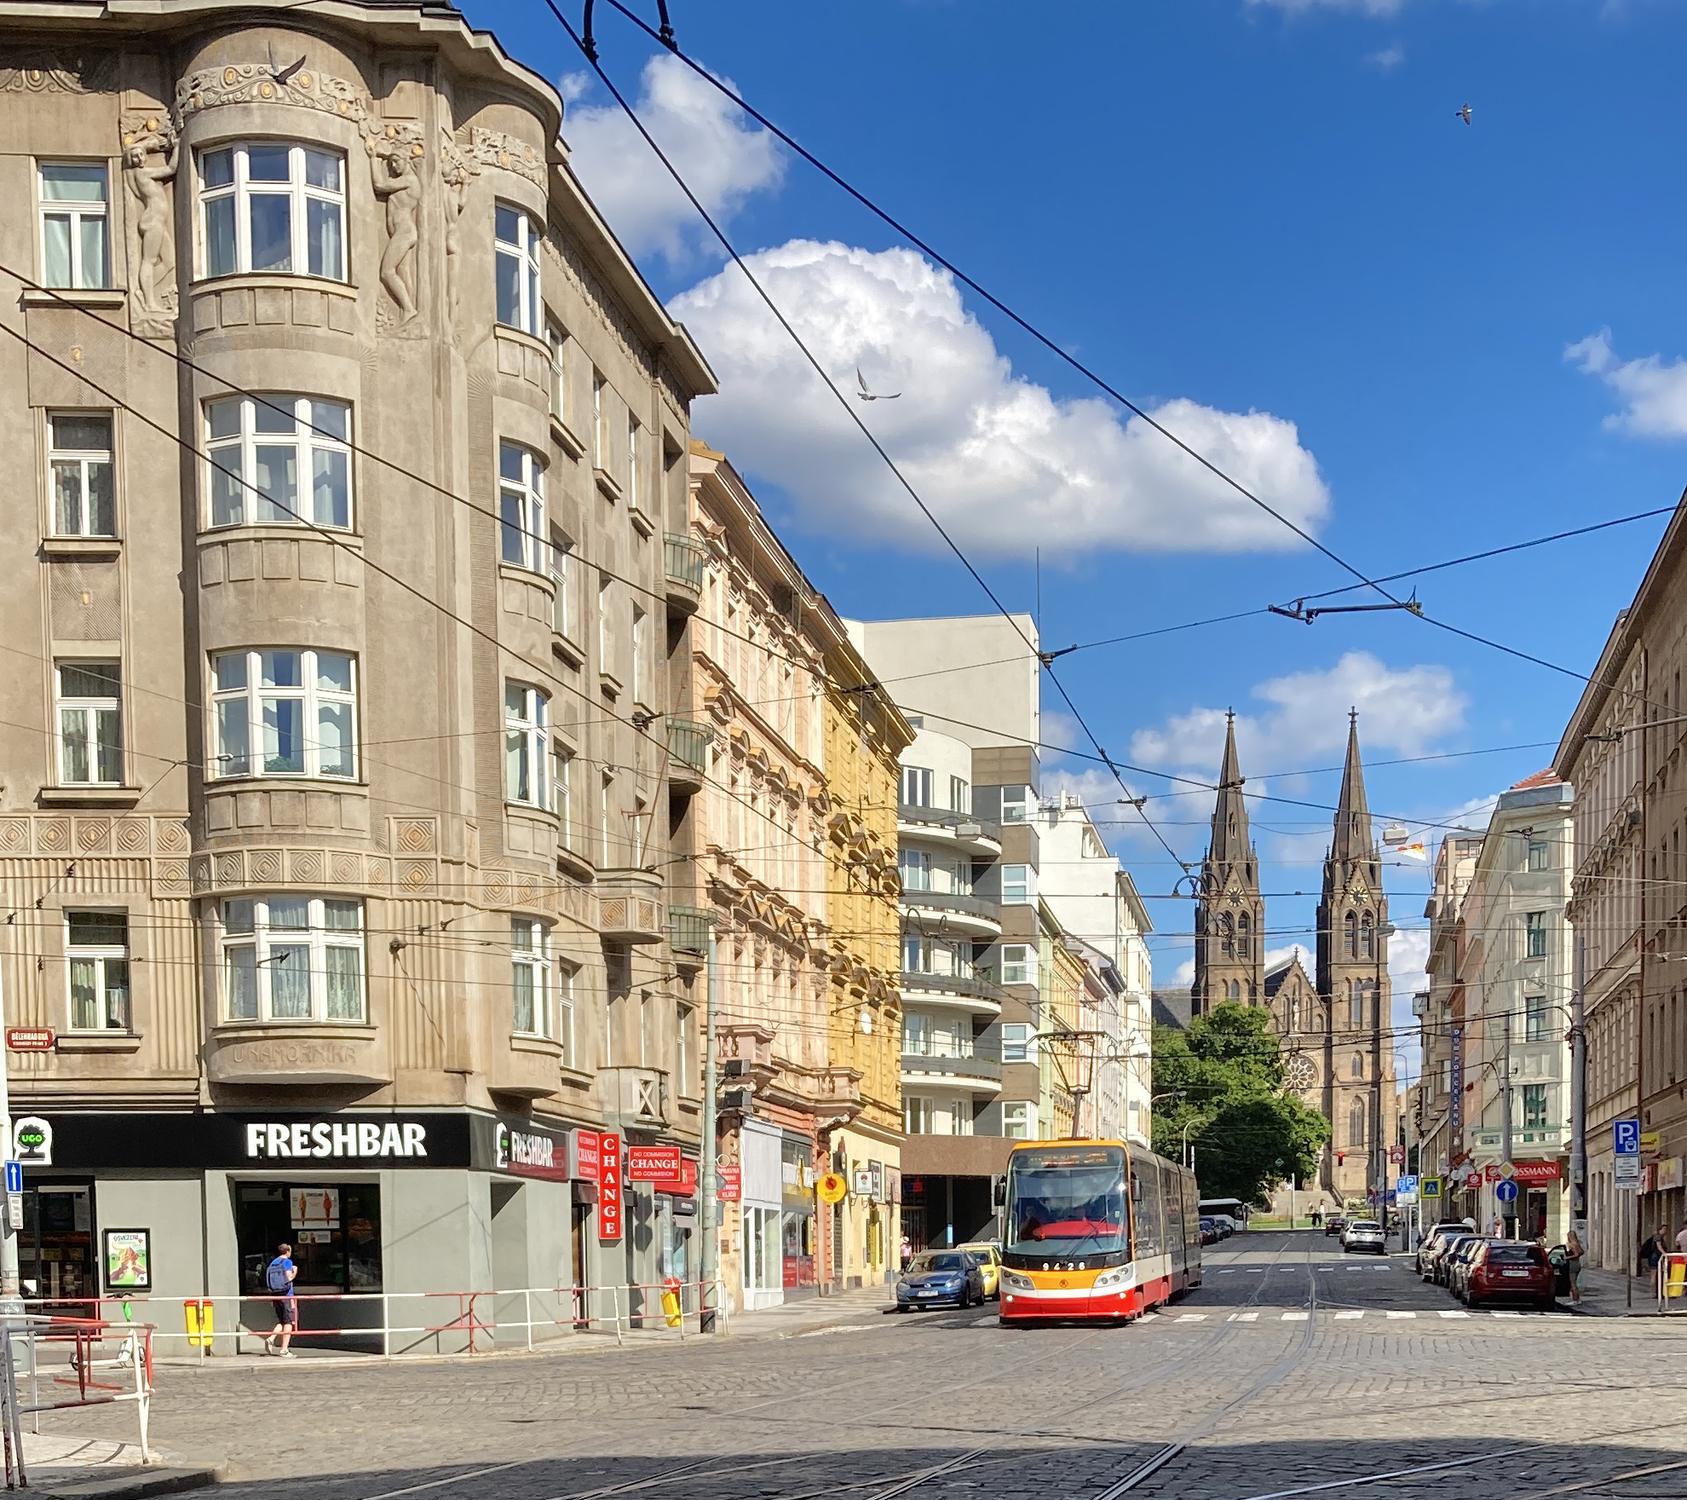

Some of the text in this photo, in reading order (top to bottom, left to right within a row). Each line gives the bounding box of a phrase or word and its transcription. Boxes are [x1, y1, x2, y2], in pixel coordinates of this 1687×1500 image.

[21, 1134, 43, 1143] UGO
[246, 1122, 428, 1158] FRESHBAR
[511, 1131, 554, 1168] FRESHBAR
[630, 1158, 679, 1169] CHANGE
[1513, 1166, 1557, 1177] OSSMANN
[603, 1138, 617, 1234] CHANGE
[1042, 1261, 1086, 1271] 9426
